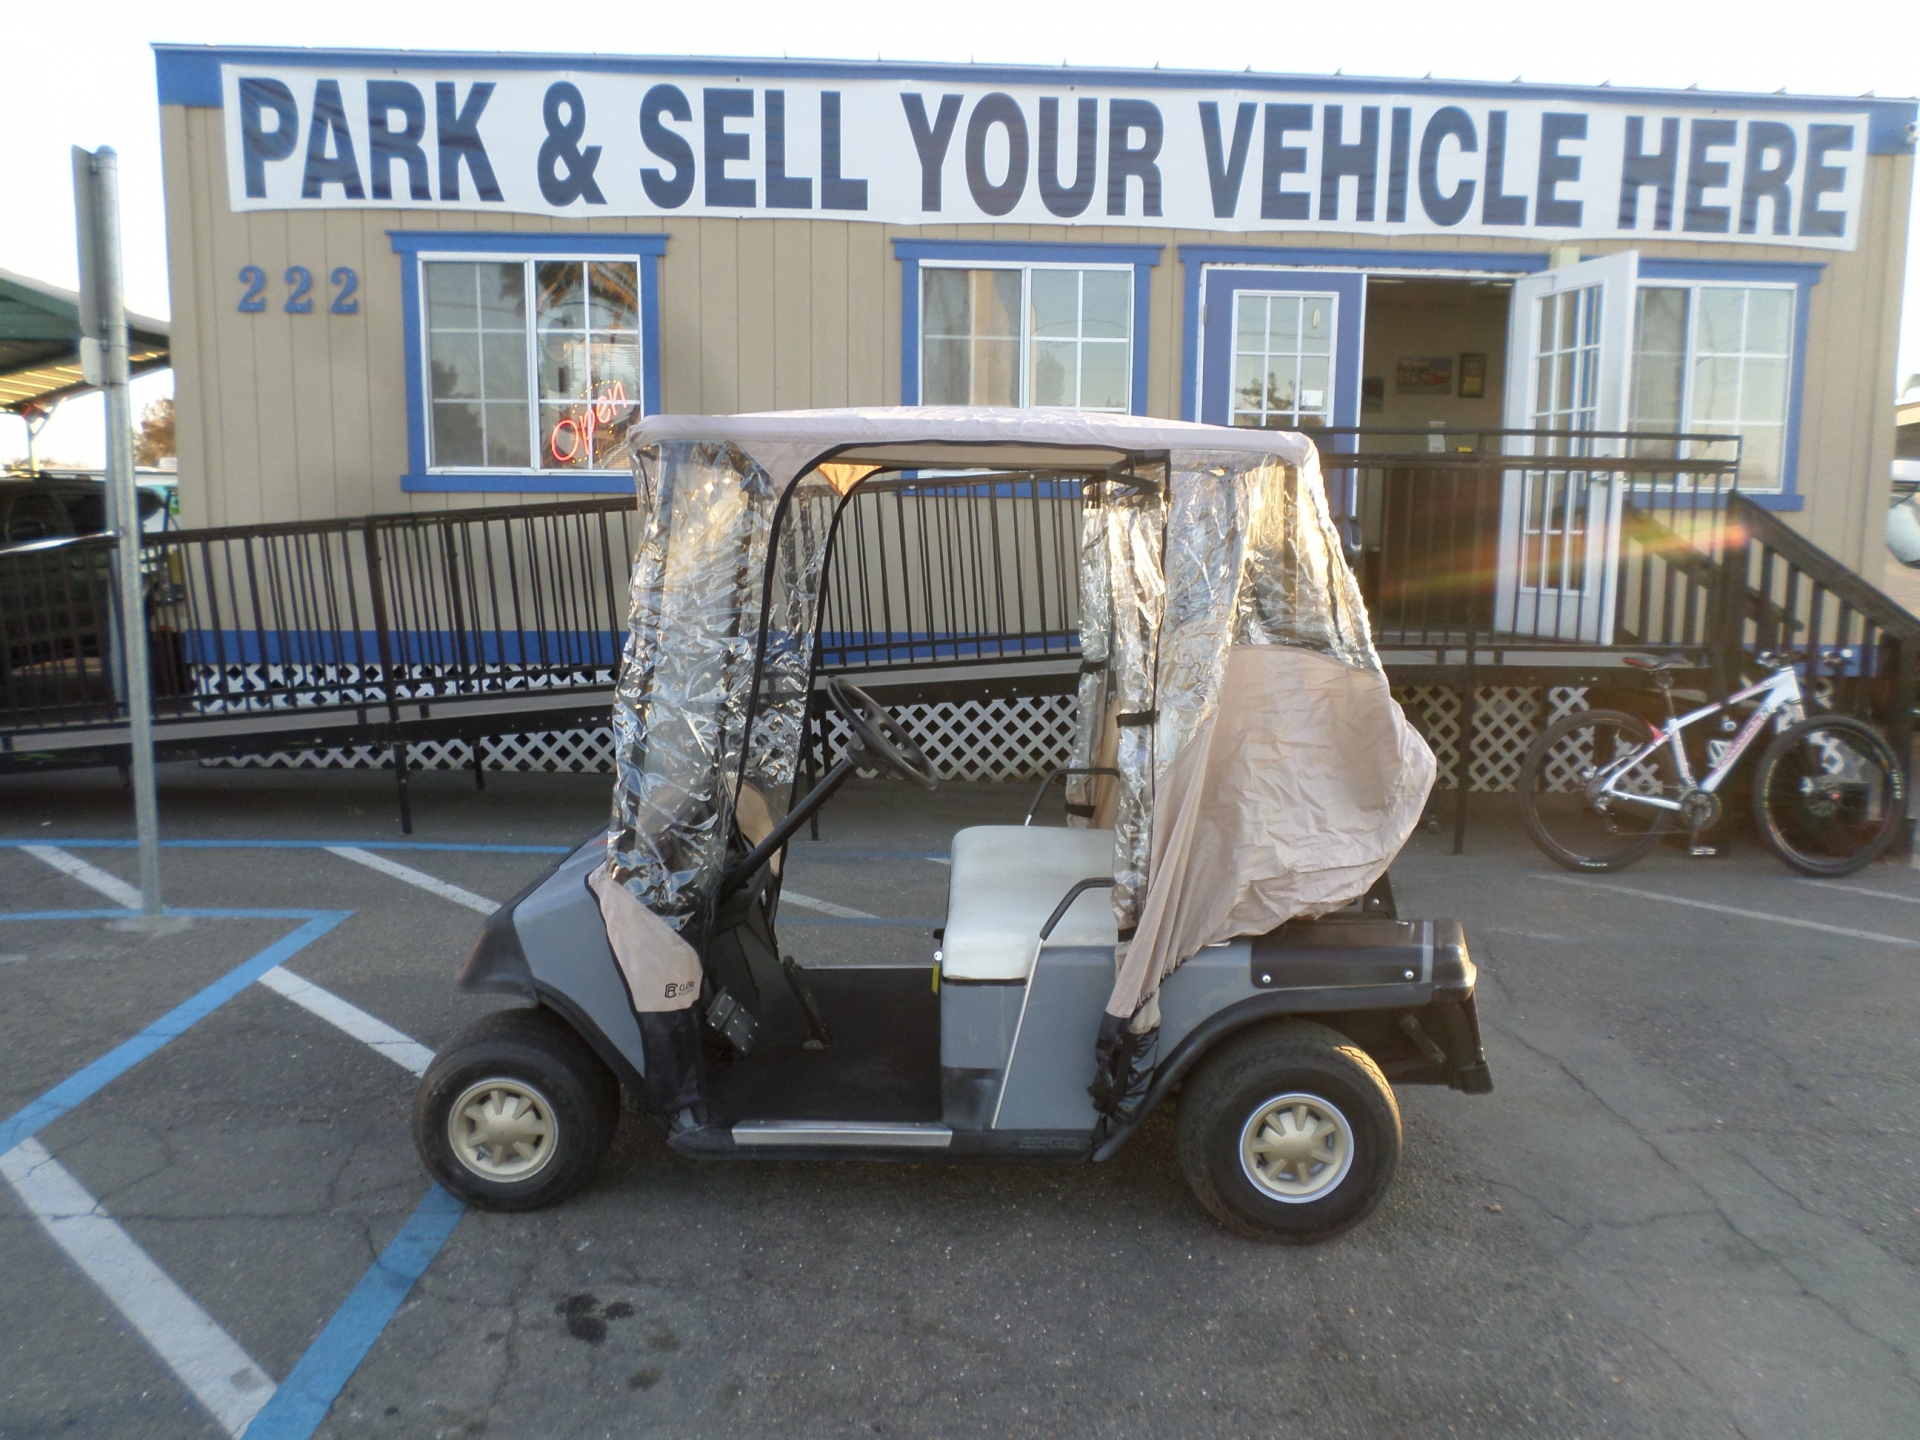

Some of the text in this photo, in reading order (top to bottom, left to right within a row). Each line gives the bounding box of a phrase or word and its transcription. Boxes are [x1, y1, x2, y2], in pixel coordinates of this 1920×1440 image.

[238, 77, 1856, 237] PARK & SELL YOUR VEHICLE HERE
[238, 265, 359, 314] 222
[551, 380, 628, 462] Open
